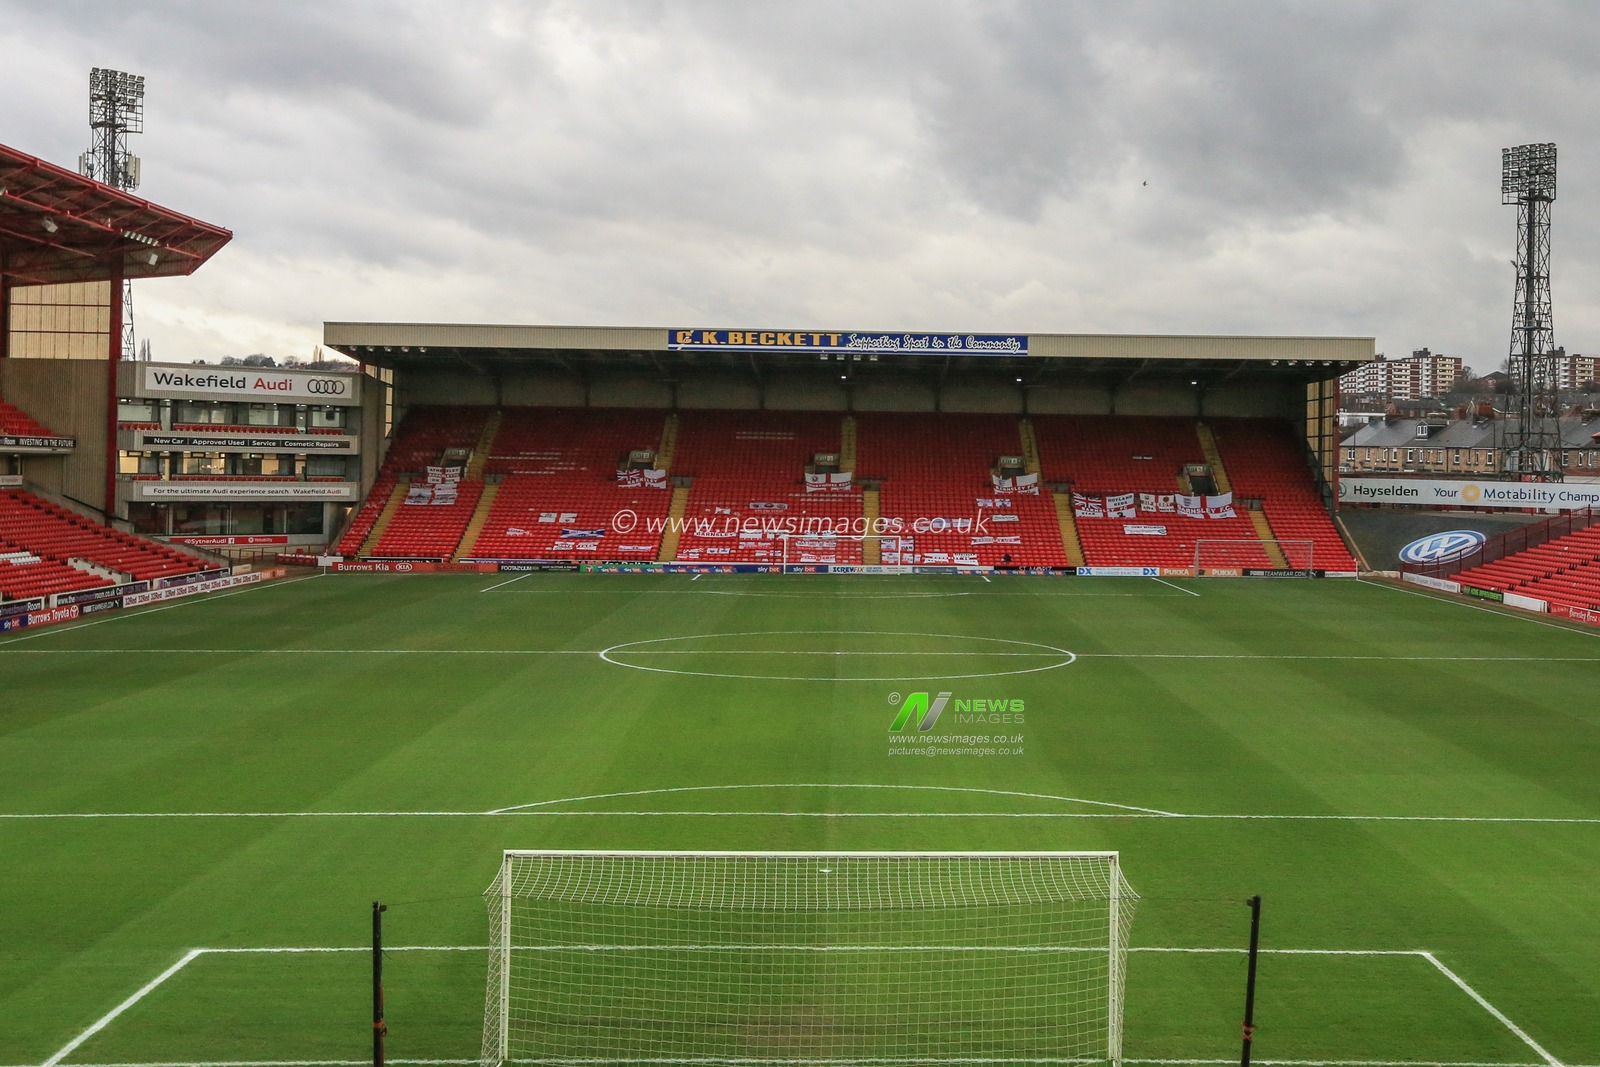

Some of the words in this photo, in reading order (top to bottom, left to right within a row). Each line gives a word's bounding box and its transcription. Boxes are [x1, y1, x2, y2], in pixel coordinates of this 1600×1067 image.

[849, 334, 900, 351] Supporting
[903, 334, 929, 351] Sport
[932, 336, 944, 348] in
[948, 336, 962, 348] the
[965, 335, 1020, 353] Community
[153, 372, 246, 389] Wakefield
[253, 377, 292, 391] Audi
[19, 438, 42, 446] INVESTING
[1353, 485, 1419, 498] Hayselden
[1434, 487, 1459, 498] Your
[1483, 488, 1556, 504] Motability
[1177, 504, 1216, 514] BARNSLEY
[1078, 567, 1093, 575] DX
[1211, 568, 1238, 576] PUKKA
[27, 612, 51, 625] Burrows
[52, 608, 70, 621] Toyota
[3, 621, 11, 630] sky
